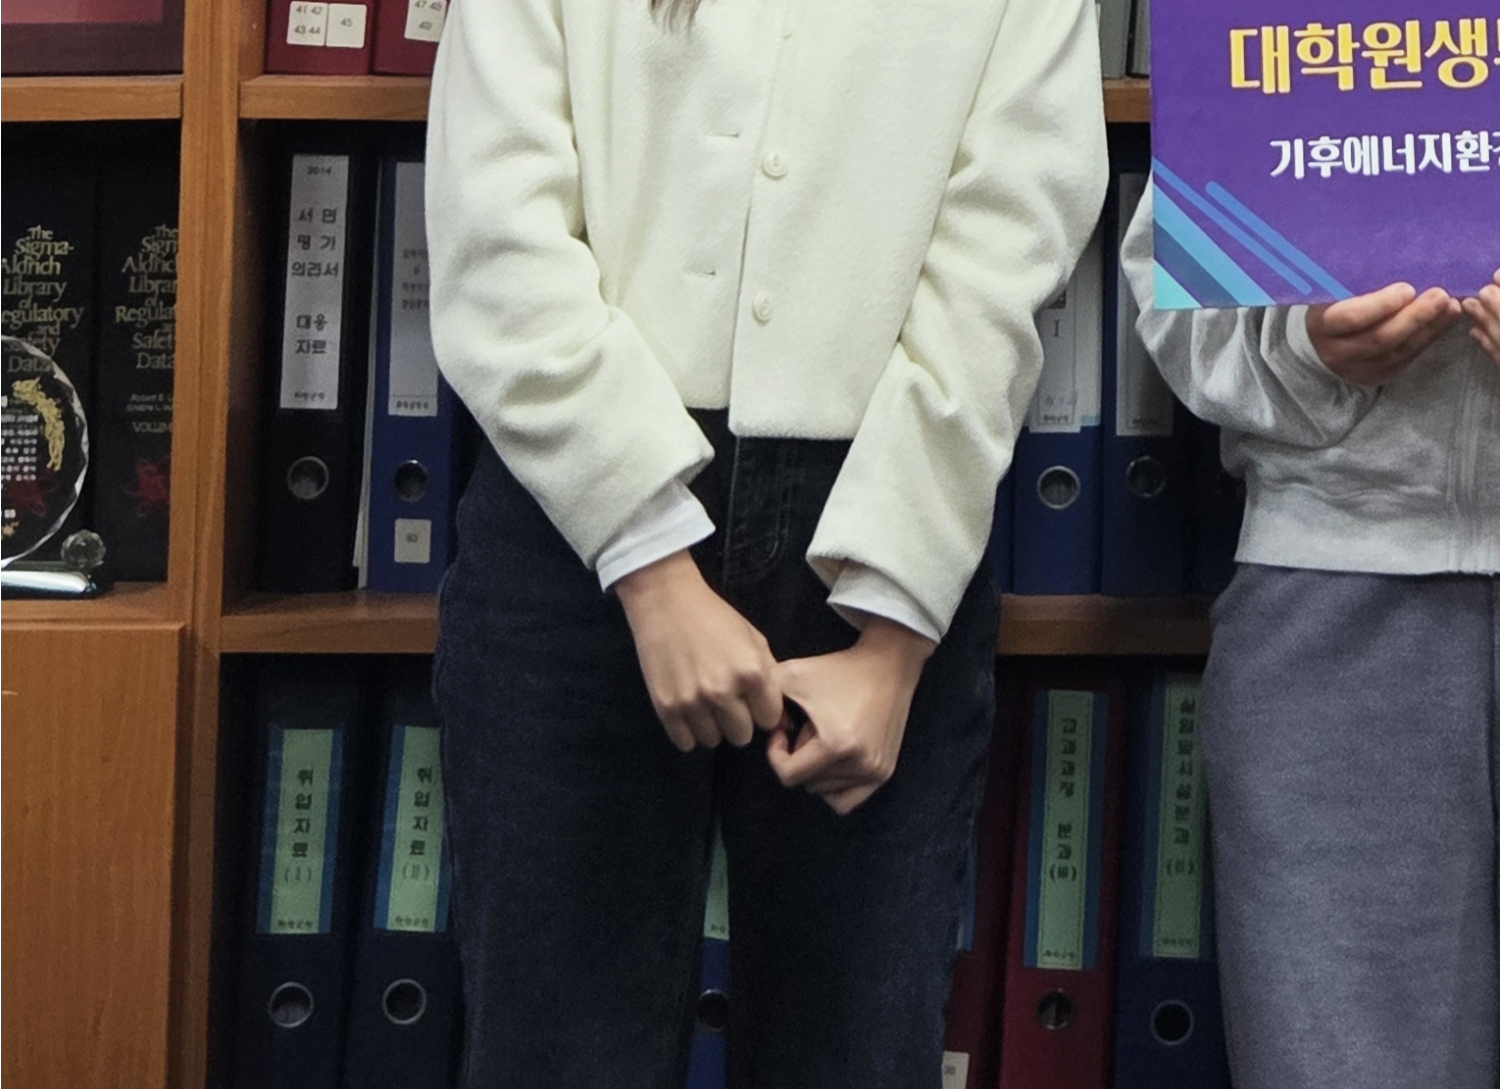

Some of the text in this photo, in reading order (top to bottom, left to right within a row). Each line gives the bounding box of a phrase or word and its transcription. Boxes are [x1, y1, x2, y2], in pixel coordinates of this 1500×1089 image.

[28, 224, 54, 240] The
[14, 237, 75, 258] Sigma-
[140, 236, 179, 256] Sigm
[121, 252, 179, 273] Aldric
[3, 277, 67, 303] Library
[0, 303, 85, 328] egulatory
[115, 303, 177, 326] Regula
[132, 331, 174, 350] Safet
[7, 355, 52, 373] Data
